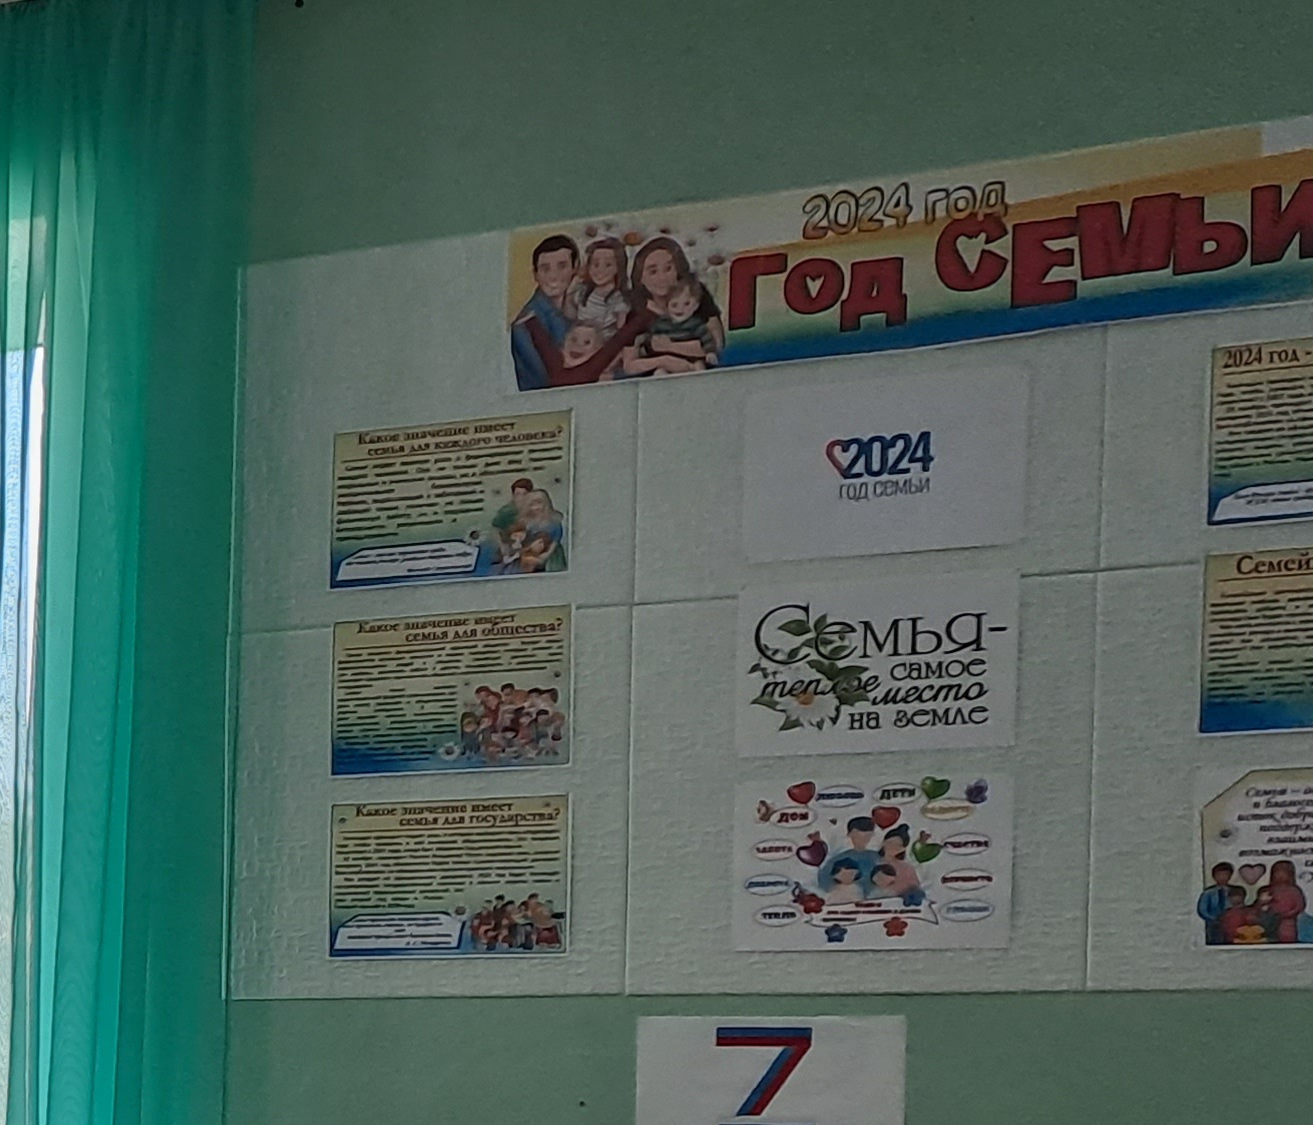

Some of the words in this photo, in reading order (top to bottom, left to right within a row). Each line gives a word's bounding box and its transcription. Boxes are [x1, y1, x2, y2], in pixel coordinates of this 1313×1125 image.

[802, 182, 913, 240] 2024
[1224, 347, 1263, 369] 2024
[842, 430, 935, 480] 2024
[357, 621, 399, 634] Какое
[405, 630, 448, 642] семья
[452, 629, 478, 641] для
[482, 617, 564, 636] общества?
[890, 658, 987, 681] самое
[871, 681, 989, 706] место
[848, 711, 880, 730] на
[894, 705, 989, 727] земле
[356, 804, 397, 817] Какое
[469, 808, 561, 827] государства?
